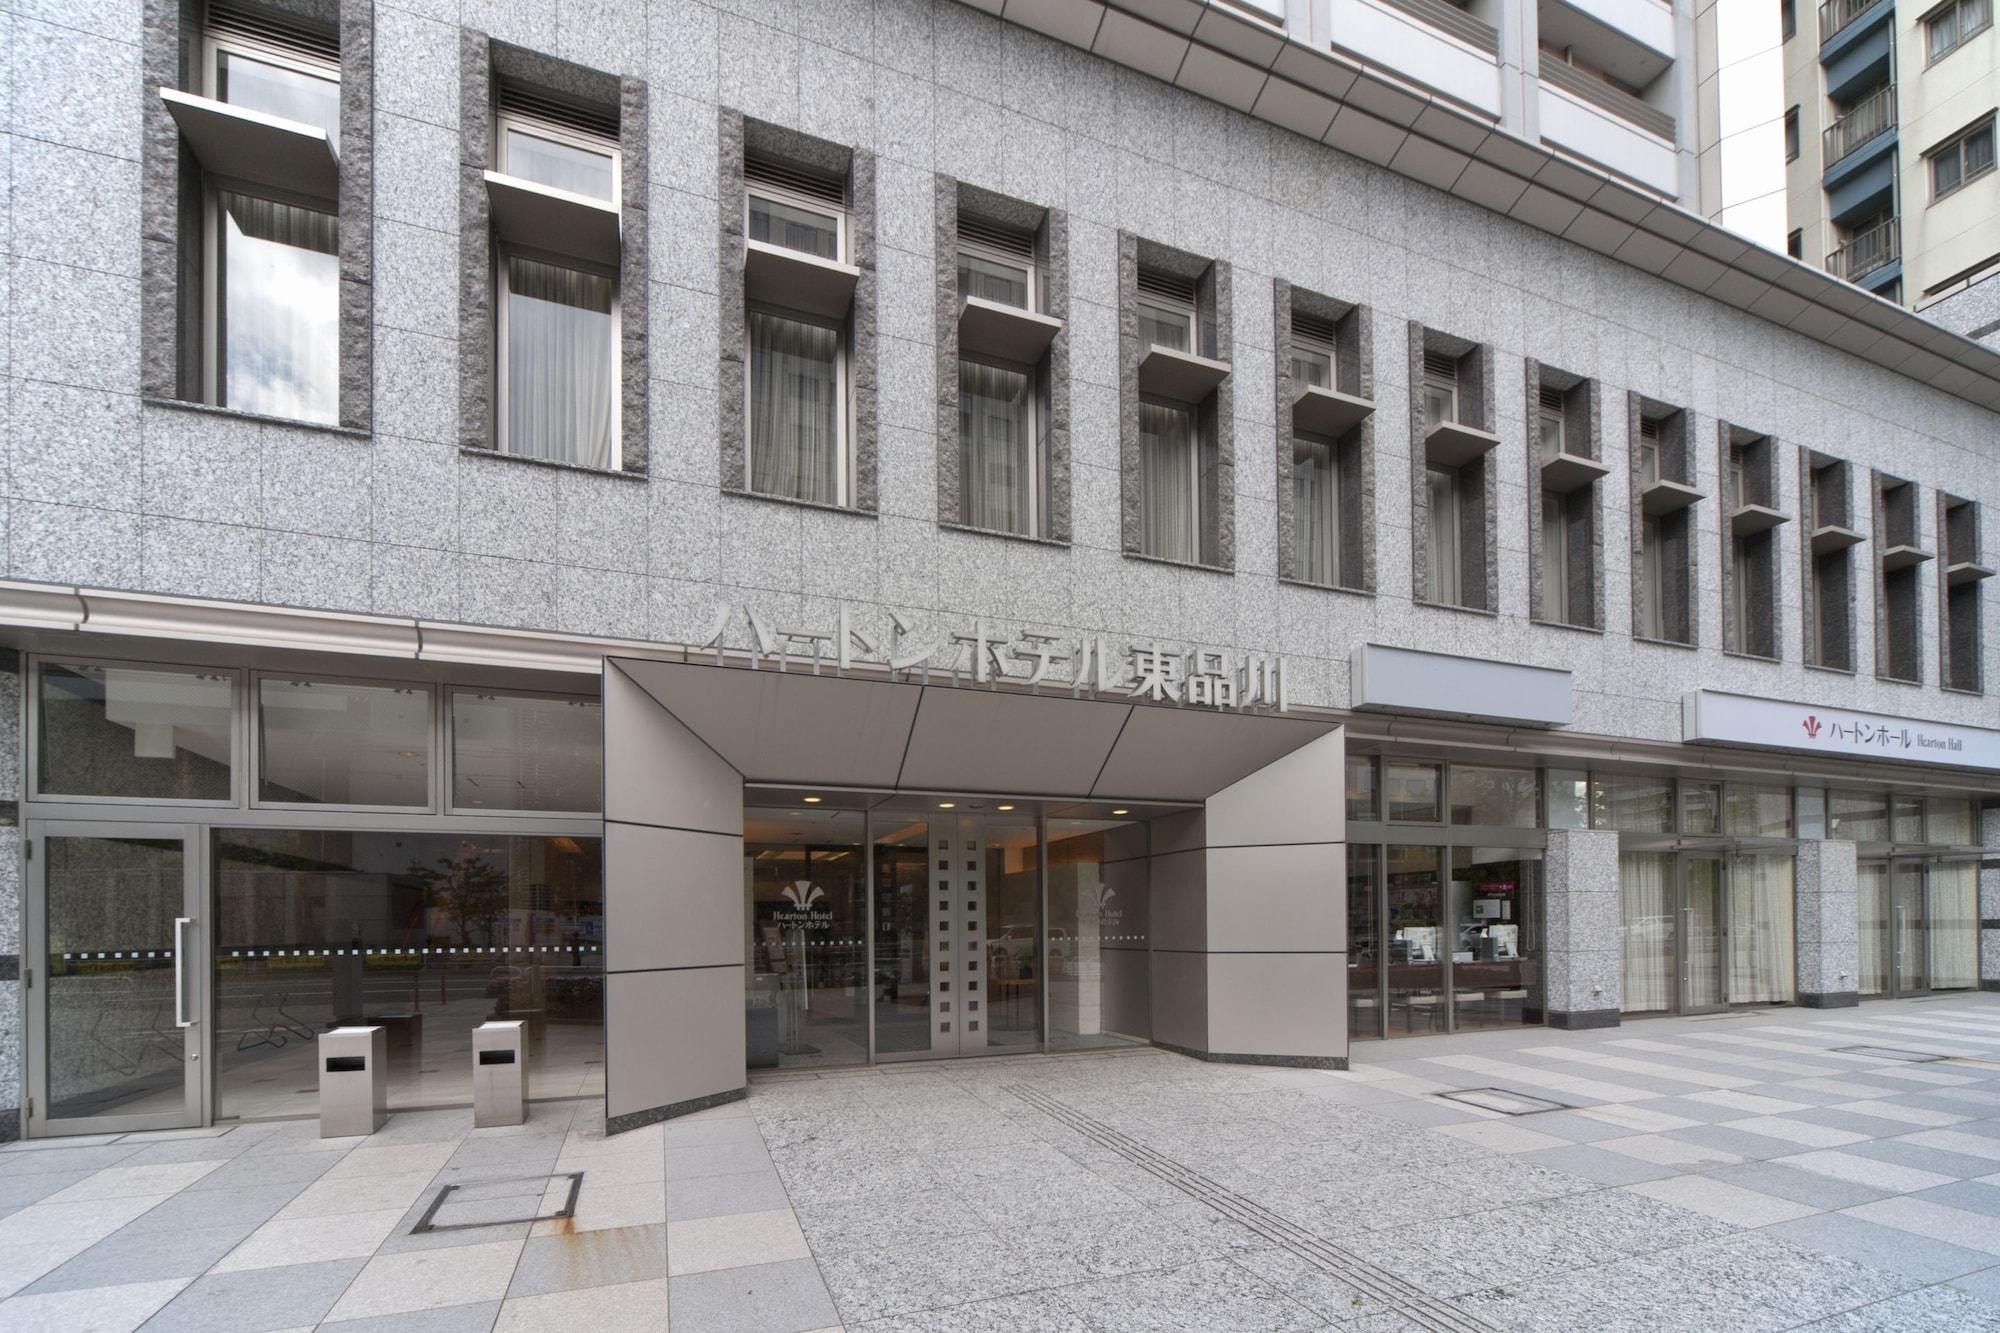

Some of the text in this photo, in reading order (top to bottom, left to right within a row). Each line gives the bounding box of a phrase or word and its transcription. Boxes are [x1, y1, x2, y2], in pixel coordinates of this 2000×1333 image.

[700, 601, 1289, 713] ハートンホテル東品川
[1830, 721, 1911, 748] ハートンホール
[1948, 737, 1963, 751] Hall
[810, 911, 833, 920] Hotel
[777, 921, 830, 929] ハートンホテル
